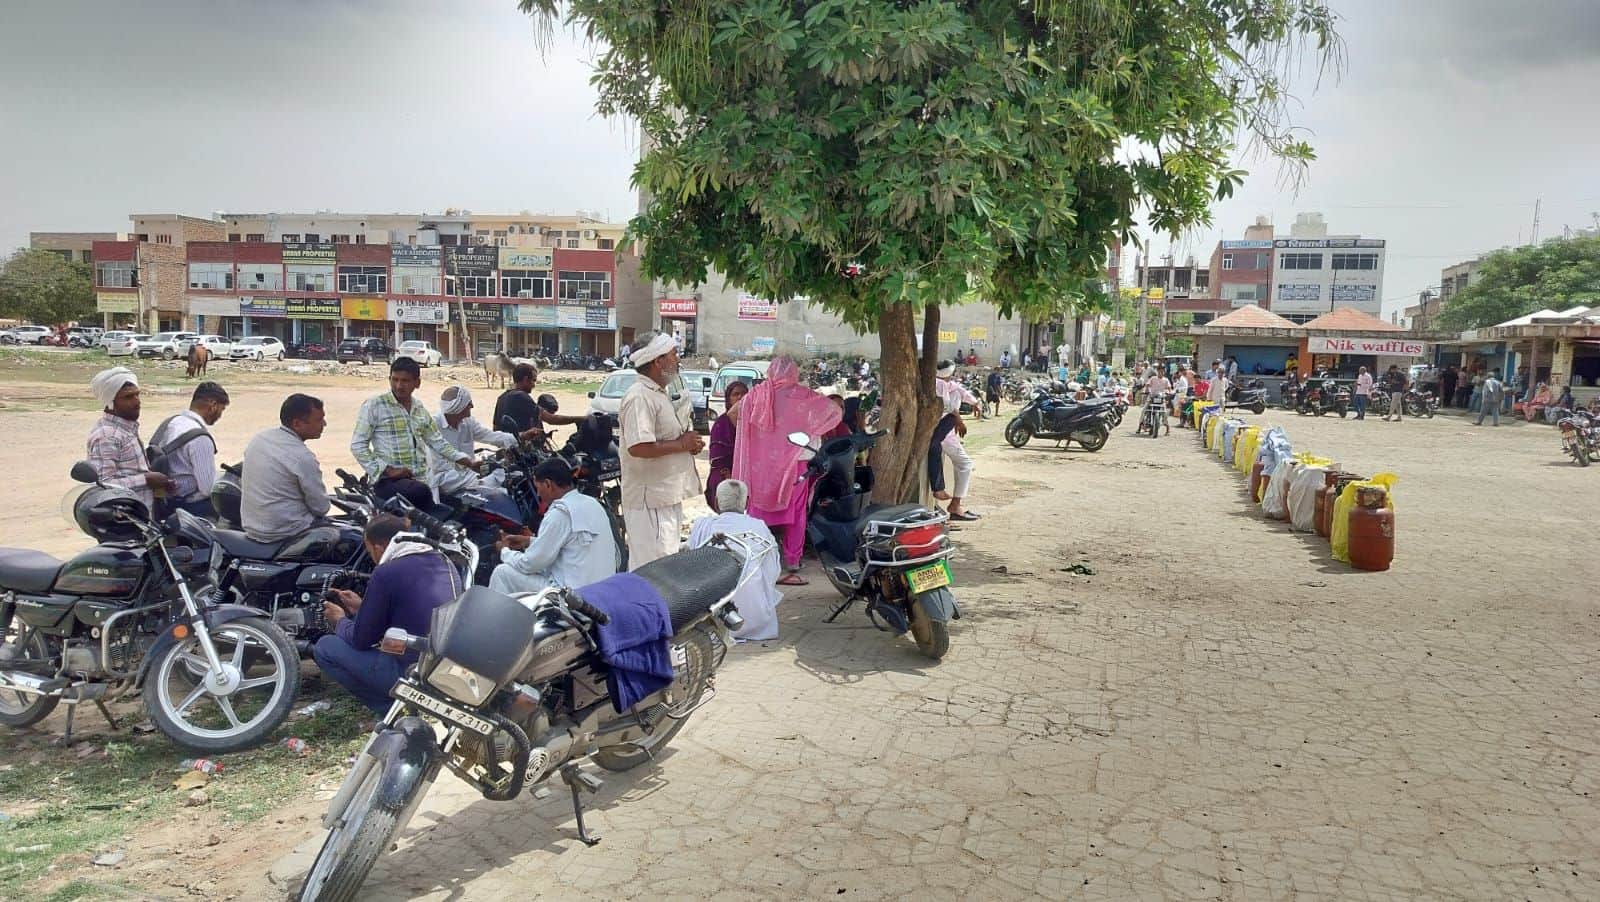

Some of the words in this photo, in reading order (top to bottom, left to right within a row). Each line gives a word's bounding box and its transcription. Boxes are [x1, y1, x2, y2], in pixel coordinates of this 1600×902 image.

[306, 305, 340, 313] PROPERTIES
[1326, 339, 1356, 350] Nik
[1361, 341, 1422, 353] waffles
[409, 690, 440, 710] HR11
[457, 713, 489, 733] 7310
